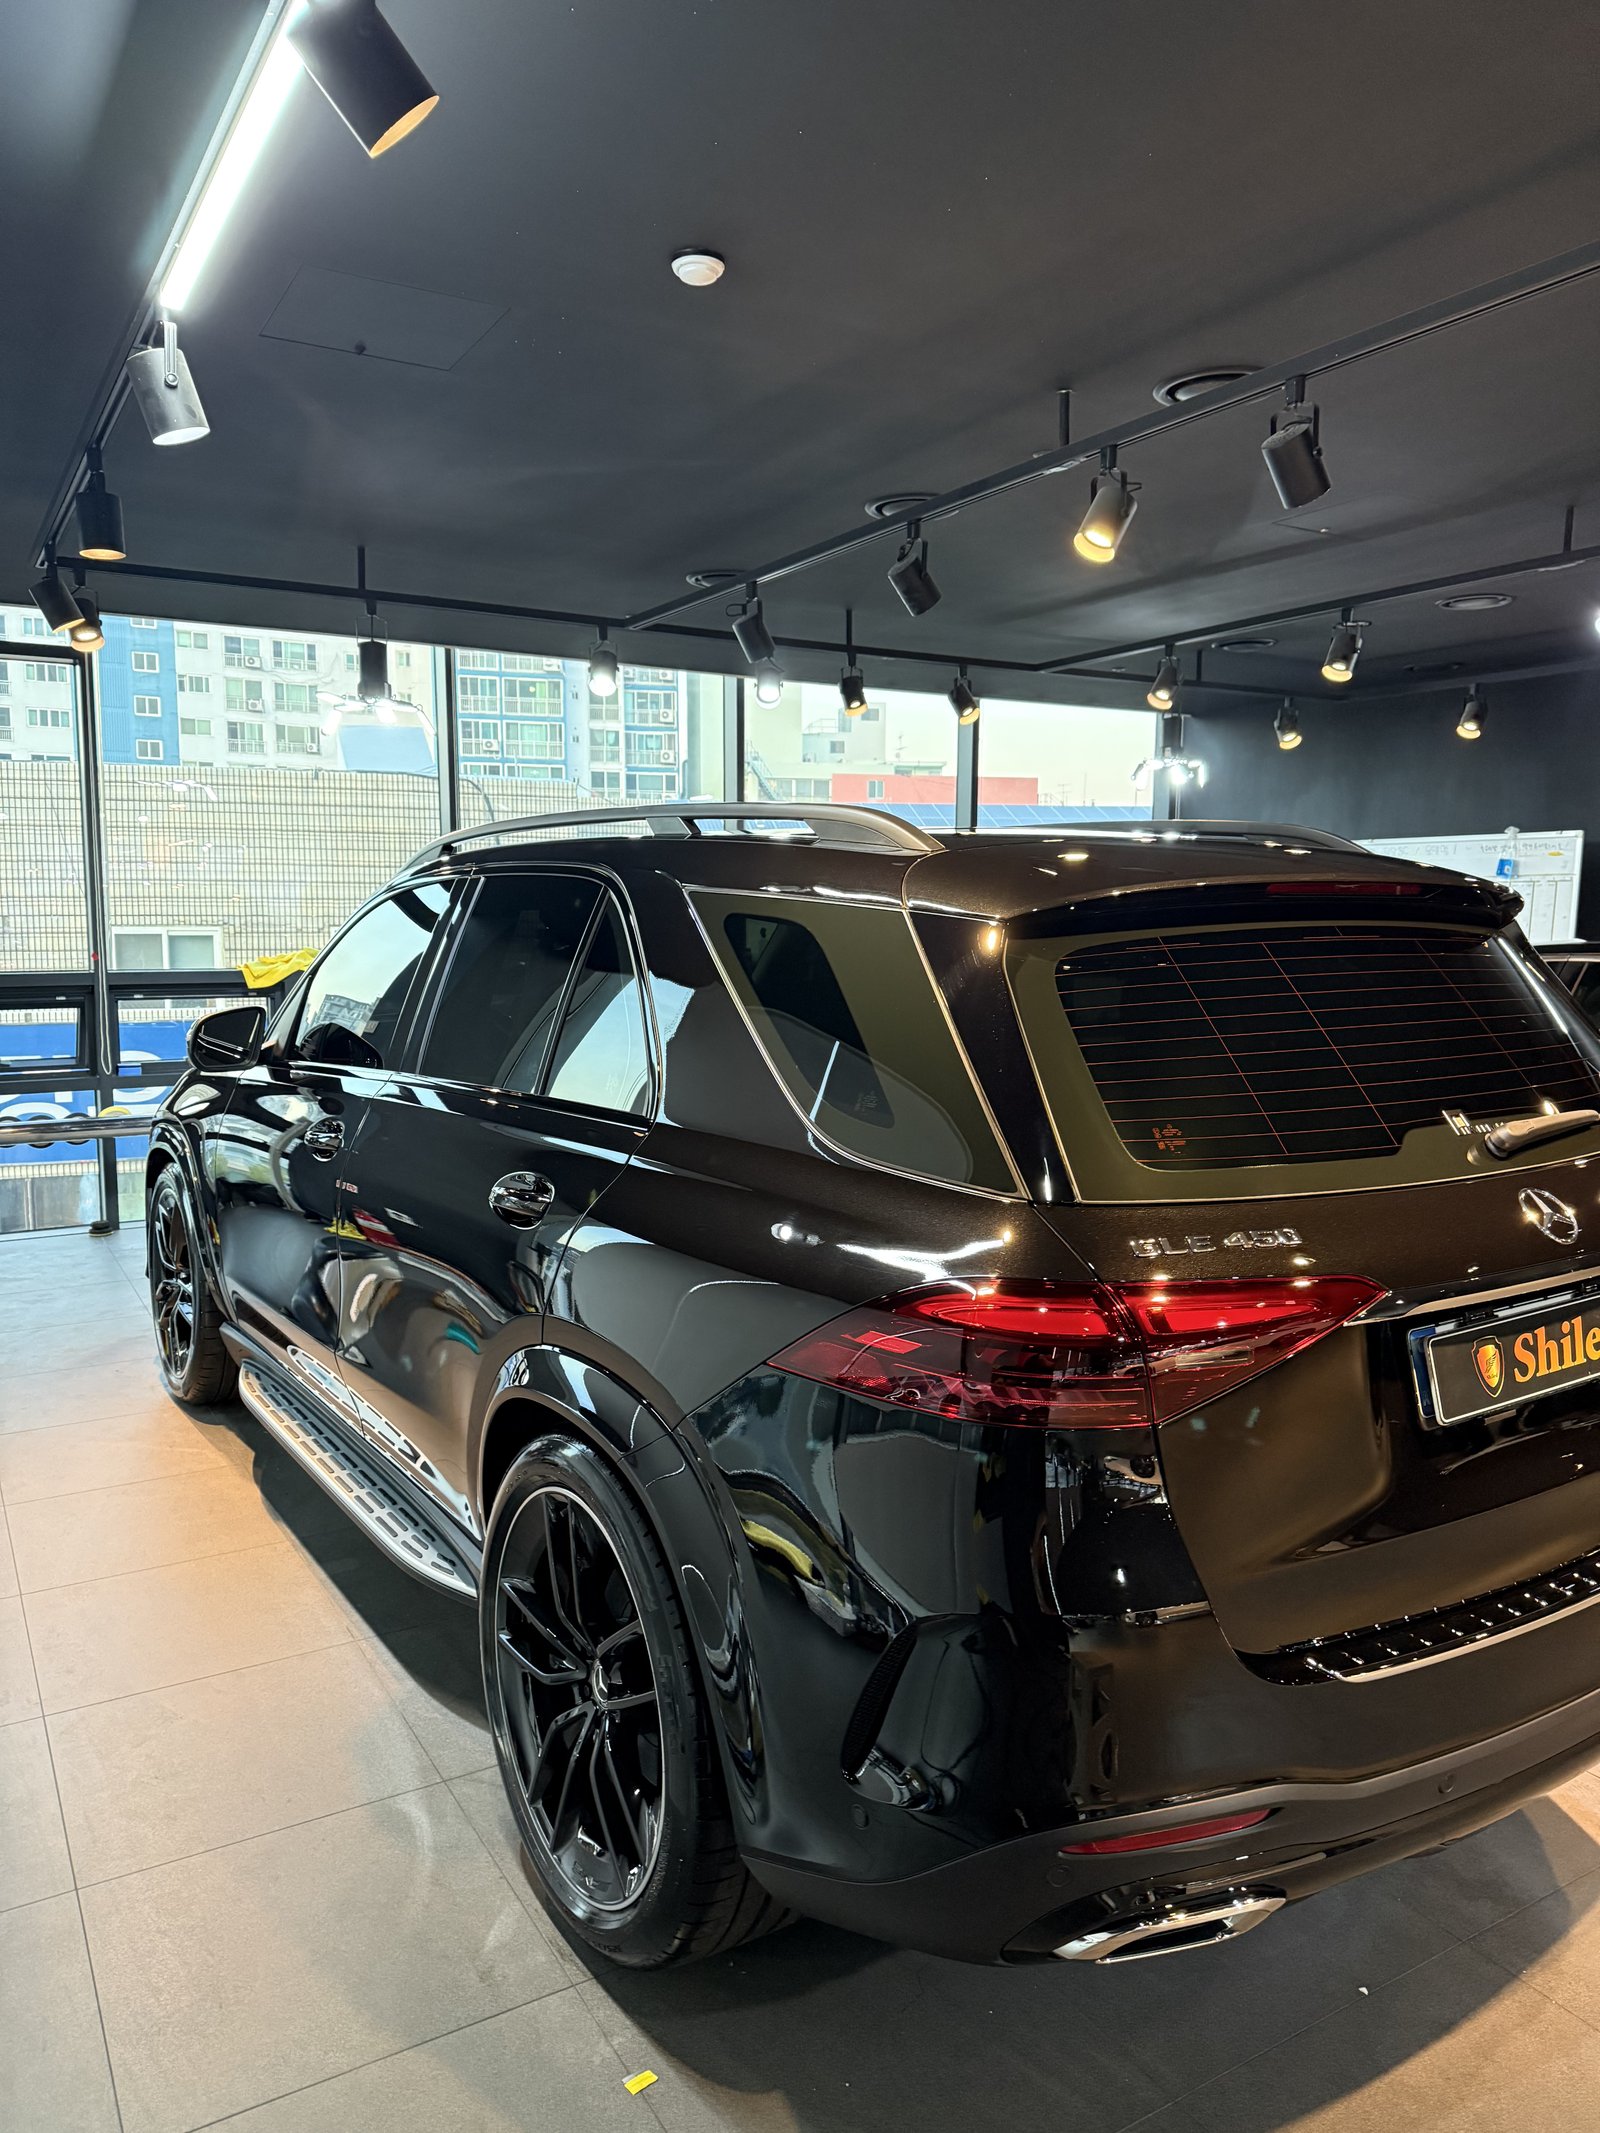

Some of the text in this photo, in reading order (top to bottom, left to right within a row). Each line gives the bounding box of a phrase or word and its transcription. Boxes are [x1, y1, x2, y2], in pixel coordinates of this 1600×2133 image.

[1129, 1228, 1302, 1258] GLE 450
[1513, 1315, 1600, 1383] Shile
